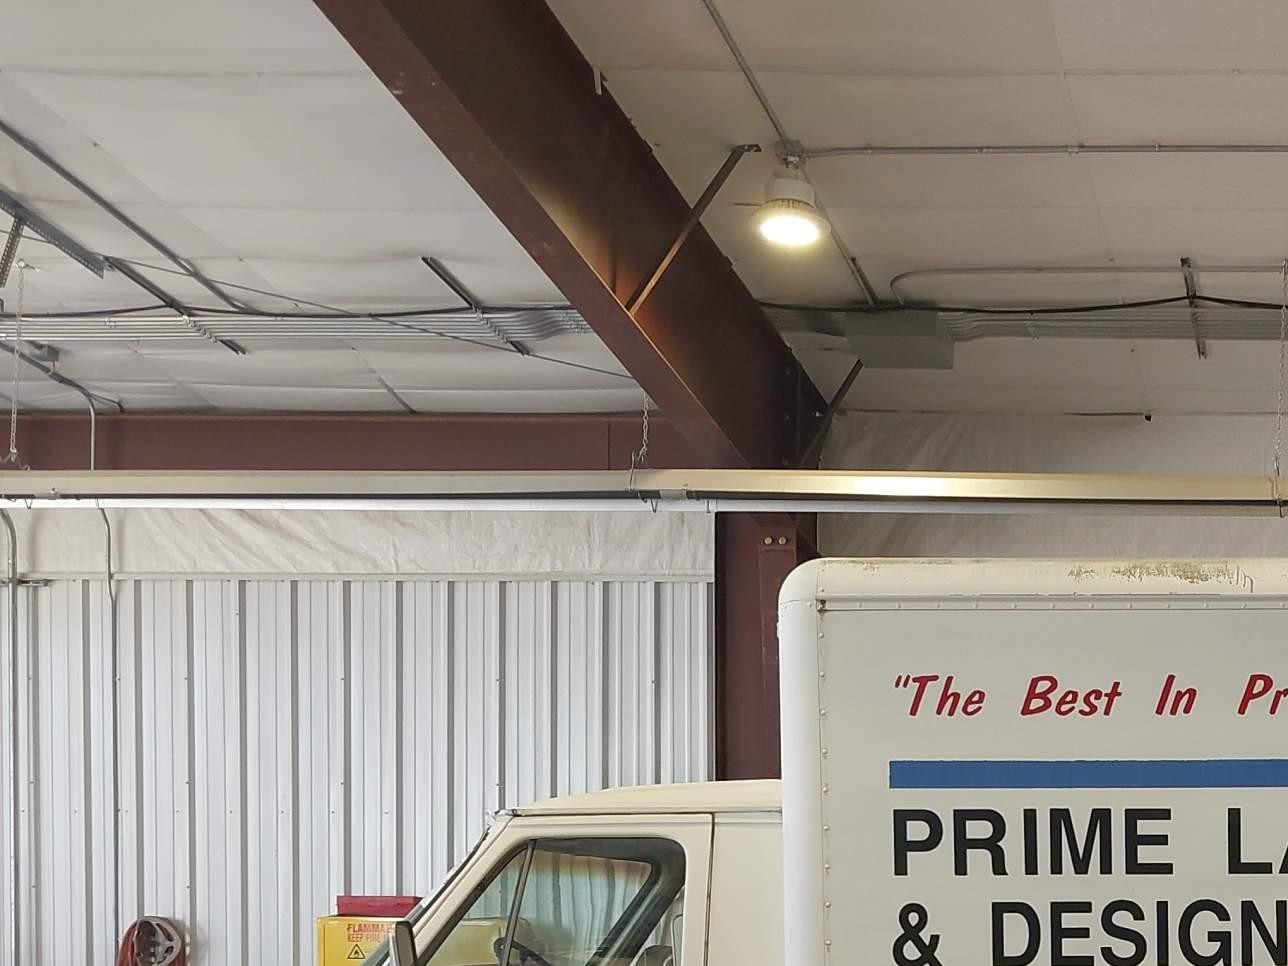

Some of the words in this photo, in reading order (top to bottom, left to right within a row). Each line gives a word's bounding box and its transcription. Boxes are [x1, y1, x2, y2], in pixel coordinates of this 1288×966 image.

[1022, 675, 1120, 717] Best
[1156, 675, 1197, 715] In
[893, 808, 1173, 876] PRIME
